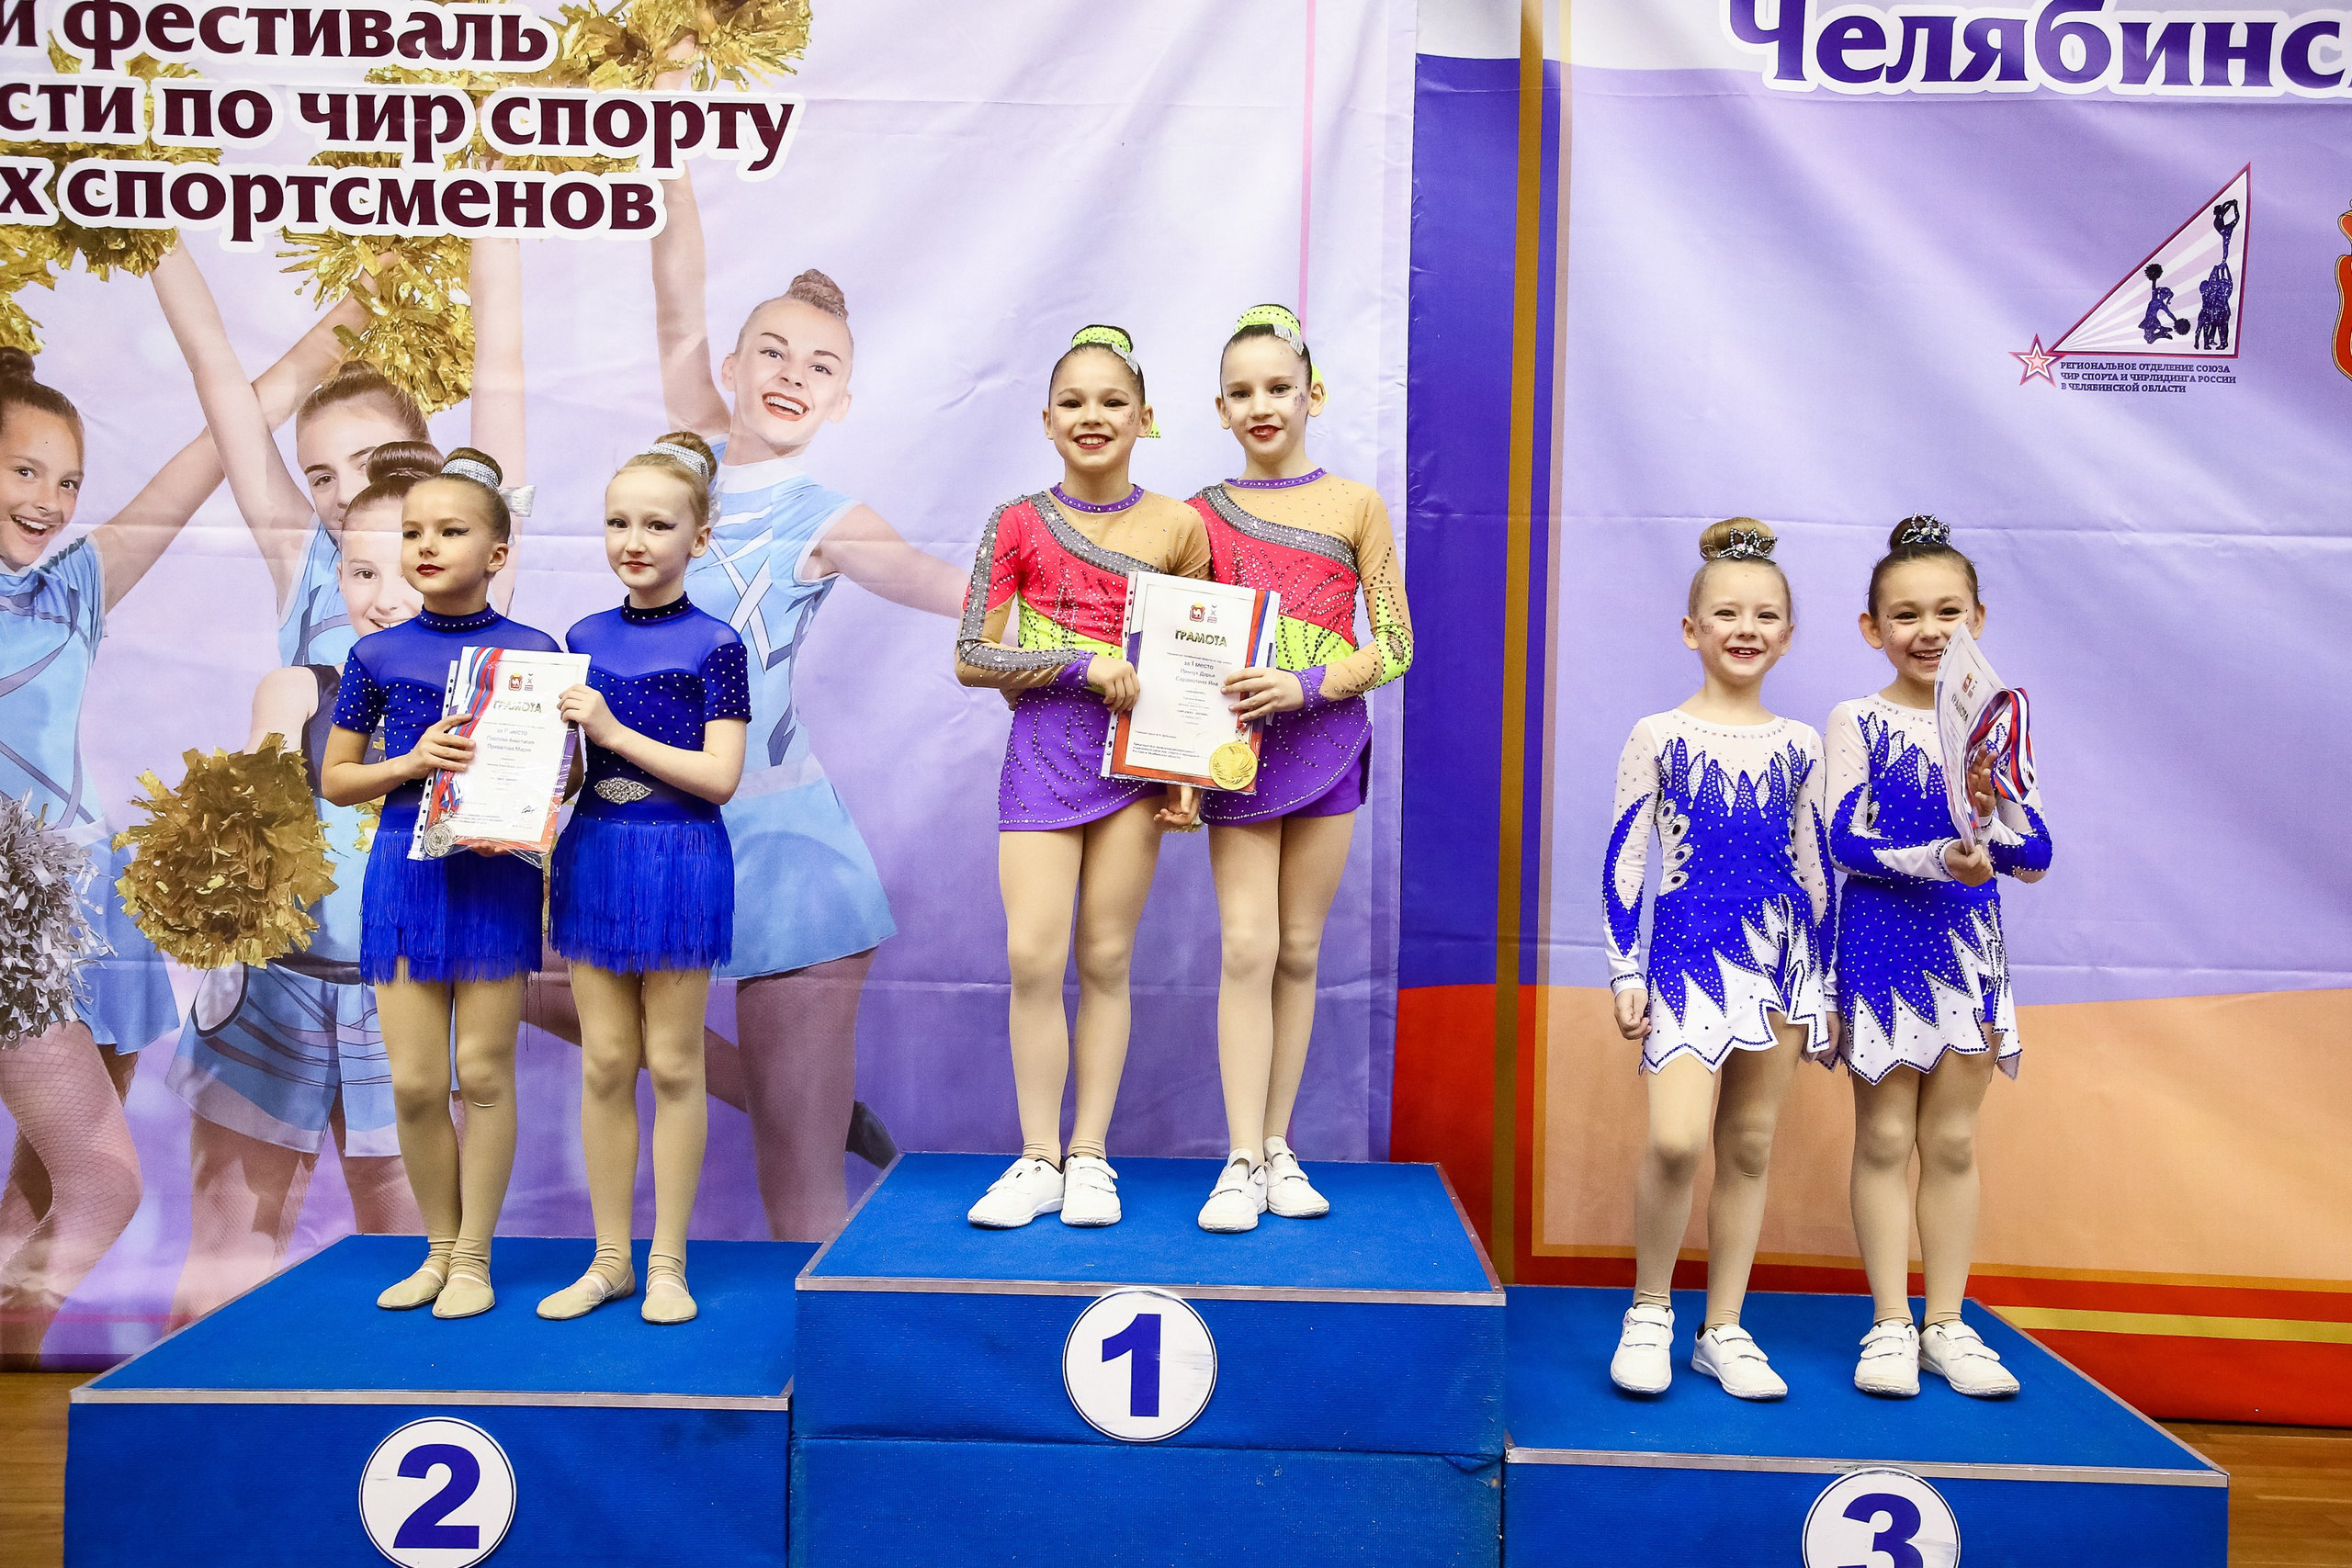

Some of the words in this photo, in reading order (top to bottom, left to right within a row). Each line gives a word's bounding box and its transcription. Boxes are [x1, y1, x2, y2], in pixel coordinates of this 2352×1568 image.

[63, 0, 548, 70] фестиваль
[1729, 0, 2352, 89] Челябинс
[0, 83, 137, 134] сти
[163, 88, 273, 139] по
[298, 93, 466, 164] чир
[492, 96, 796, 172] спорту
[67, 168, 657, 243] спортсменов
[2060, 362, 2137, 371] РЕГИОНАЛЬНОЕ
[2138, 363, 2194, 372] ОТДЕЛЕНИЕ
[2196, 365, 2231, 374] СОЮЗА
[2060, 372, 2080, 380] ЧИР
[2081, 373, 2119, 382] СПОРТА
[2120, 374, 2128, 382] И
[2130, 374, 2197, 383] ЧИРЛИДИНГА
[2198, 375, 2237, 384] РОССИИ
[2068, 382, 2140, 392] ЧЕЛЯБИНСКОЙ
[2141, 384, 2187, 393] ОБЛАСТИ
[1175, 628, 1227, 648] ГРАМОТА
[1194, 662, 1215, 671] место
[1102, 1313, 1161, 1417] 1
[392, 1443, 481, 1550] 2
[1838, 1493, 1924, 1568] 3
